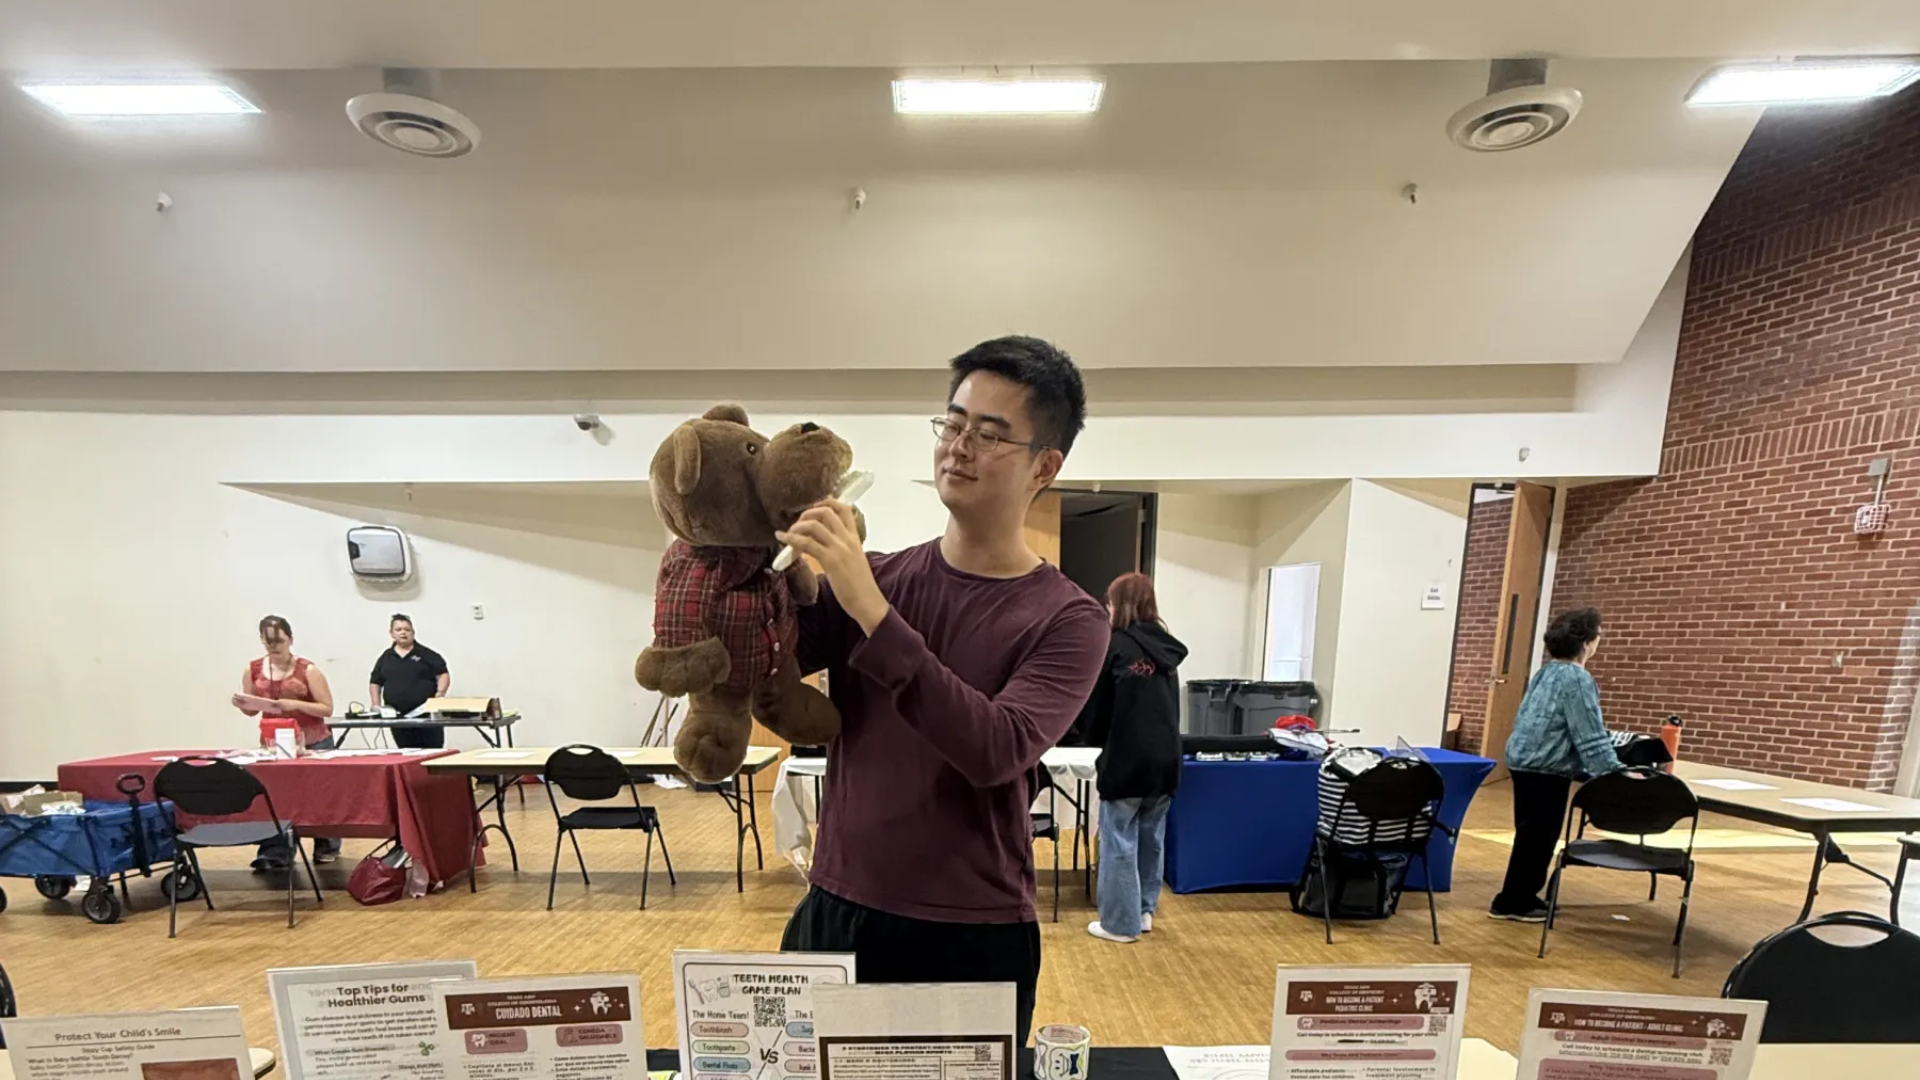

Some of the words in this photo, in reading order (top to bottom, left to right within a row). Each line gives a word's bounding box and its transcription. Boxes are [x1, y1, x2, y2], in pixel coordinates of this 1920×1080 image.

[733, 974, 766, 983] TEETH
[768, 974, 808, 984] HEALTH
[337, 987, 360, 999] Top
[362, 985, 389, 995] Tips
[742, 986, 772, 994] GAME
[774, 987, 801, 995] PLAN
[328, 997, 386, 1008] Healthier
[388, 994, 426, 1004] Gums
[496, 1007, 530, 1019] CUIDADO
[532, 1005, 562, 1018] DENTAL
[728, 1011, 749, 1019] Team!
[699, 1025, 732, 1034] Toothbrush
[802, 1026, 814, 1034] Sug
[1621, 1021, 1644, 1029] PATIENT
[1666, 1024, 1684, 1032] CLINIC
[55, 1032, 93, 1042] Protect
[95, 1030, 116, 1039] Your
[119, 1028, 152, 1038] Child's
[155, 1027, 181, 1036] Smile
[702, 1043, 736, 1053] Toothpaste
[760, 1048, 779, 1064] VS
